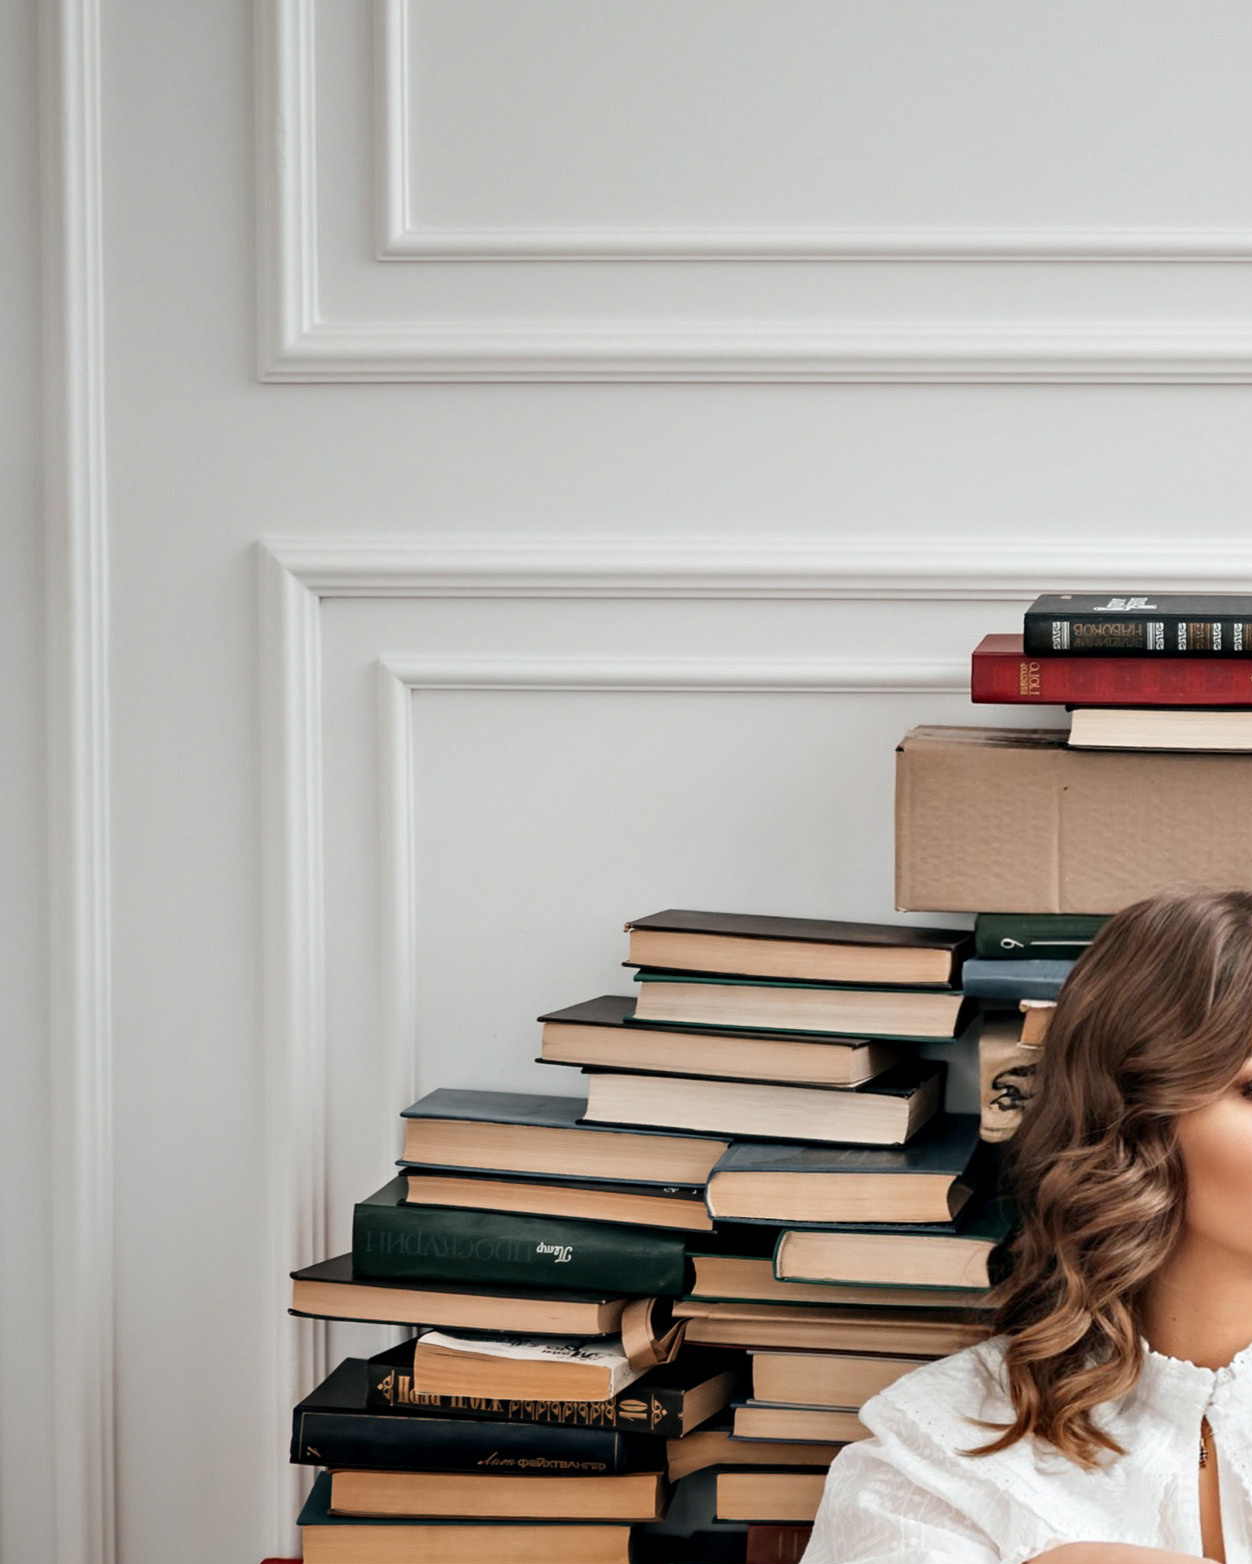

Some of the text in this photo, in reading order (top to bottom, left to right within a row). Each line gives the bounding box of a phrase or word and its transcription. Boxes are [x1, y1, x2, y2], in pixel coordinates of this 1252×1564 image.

[1073, 623, 1143, 637] НАБОКОВ
[1029, 662, 1041, 696] ГЮГО
[536, 1241, 574, 1263] Петр
[619, 1399, 648, 1421] 10
